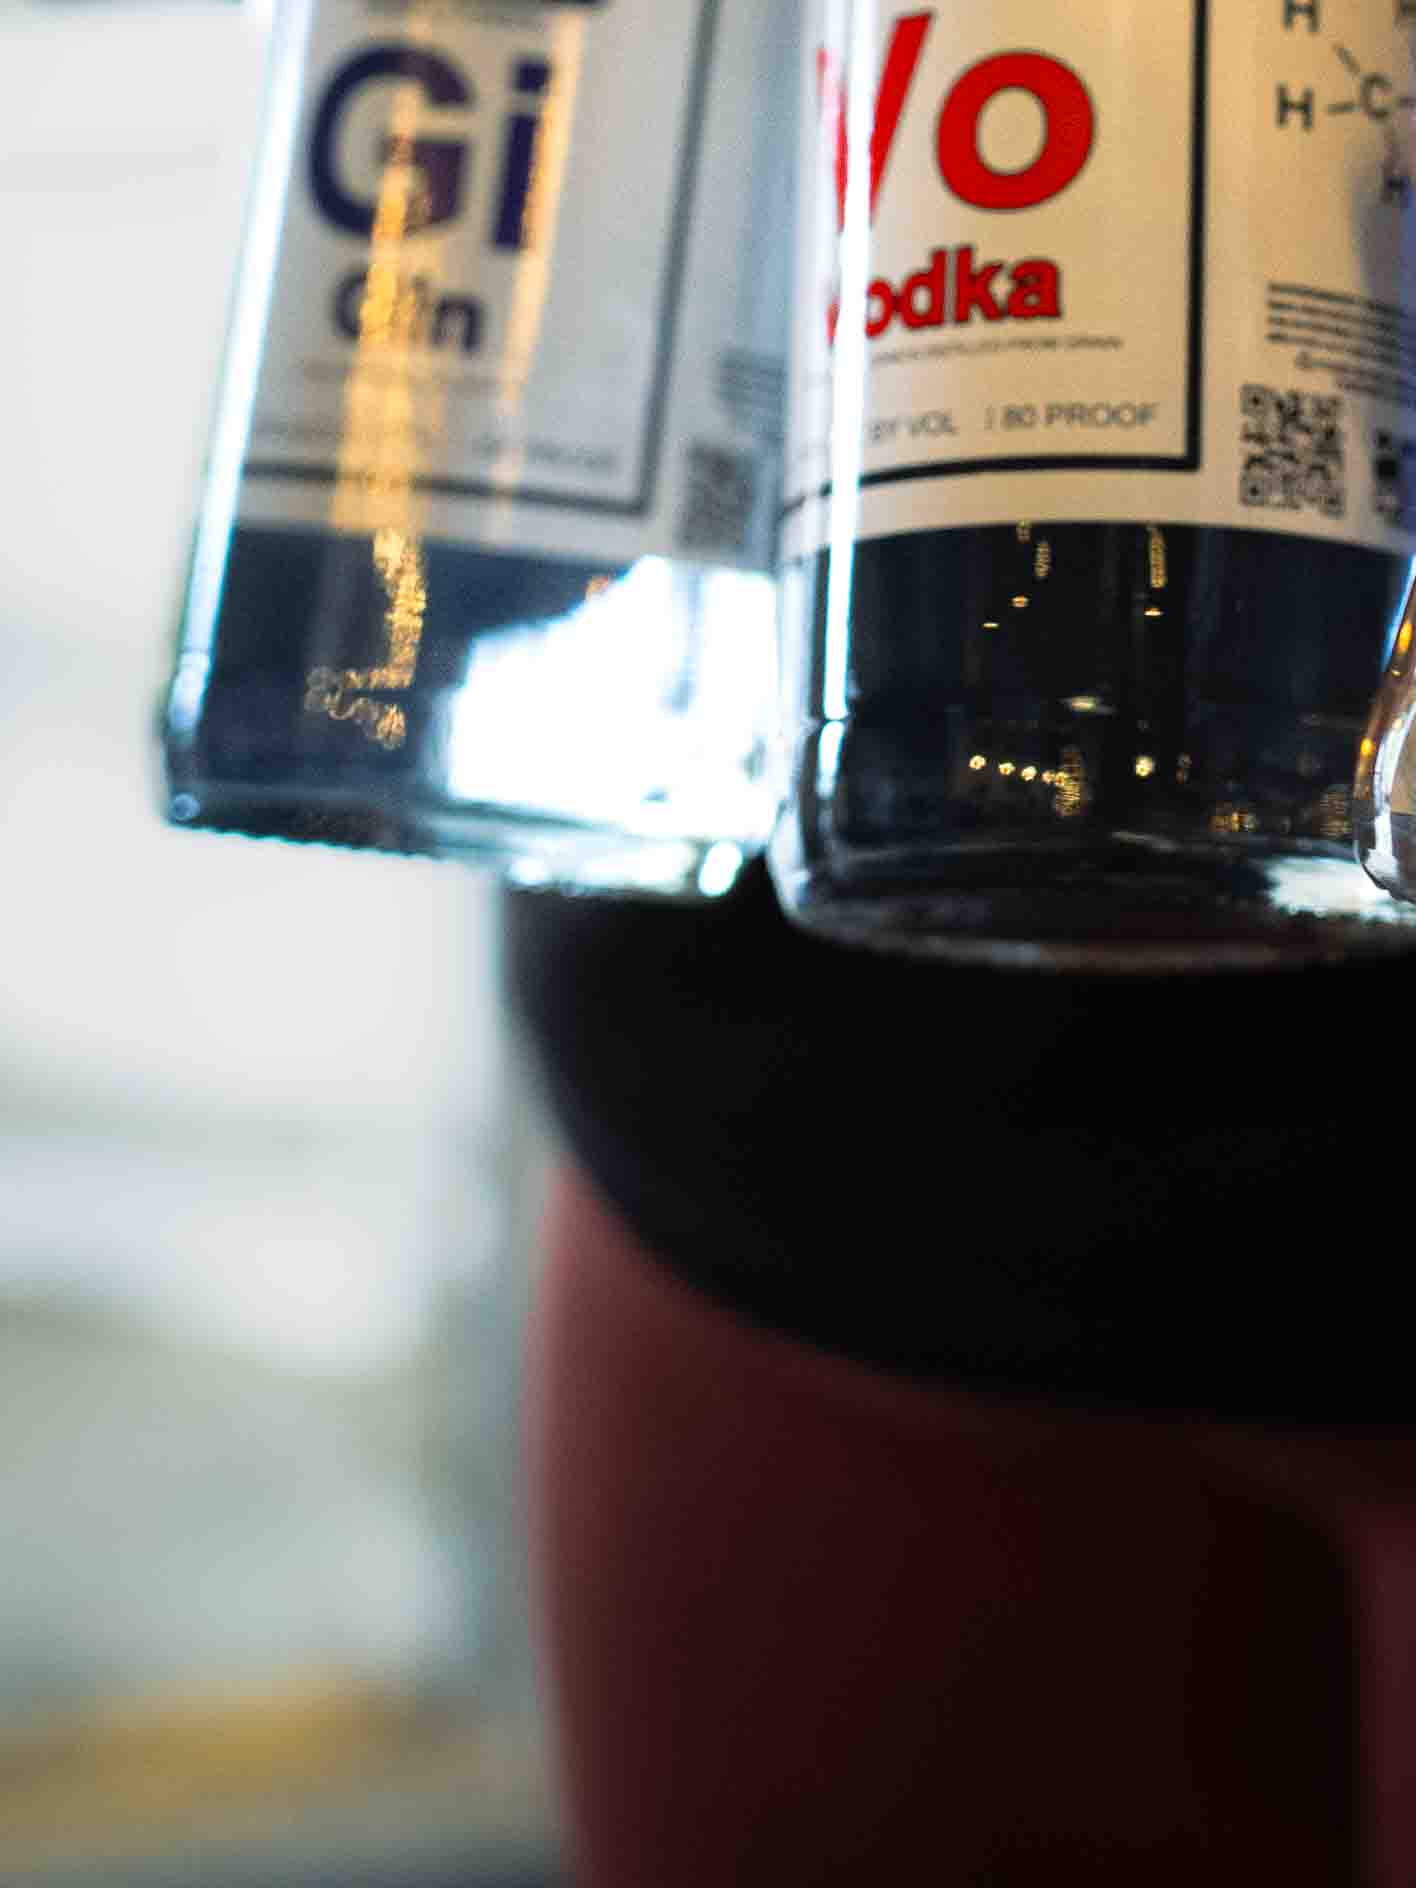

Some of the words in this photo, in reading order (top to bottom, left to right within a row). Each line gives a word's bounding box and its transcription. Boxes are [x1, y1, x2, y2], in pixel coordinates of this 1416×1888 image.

[306, 39, 554, 257] Gi
[816, 10, 1097, 235] Vo
[1002, 402, 1036, 430] 80
[1044, 400, 1160, 431] PROOF
